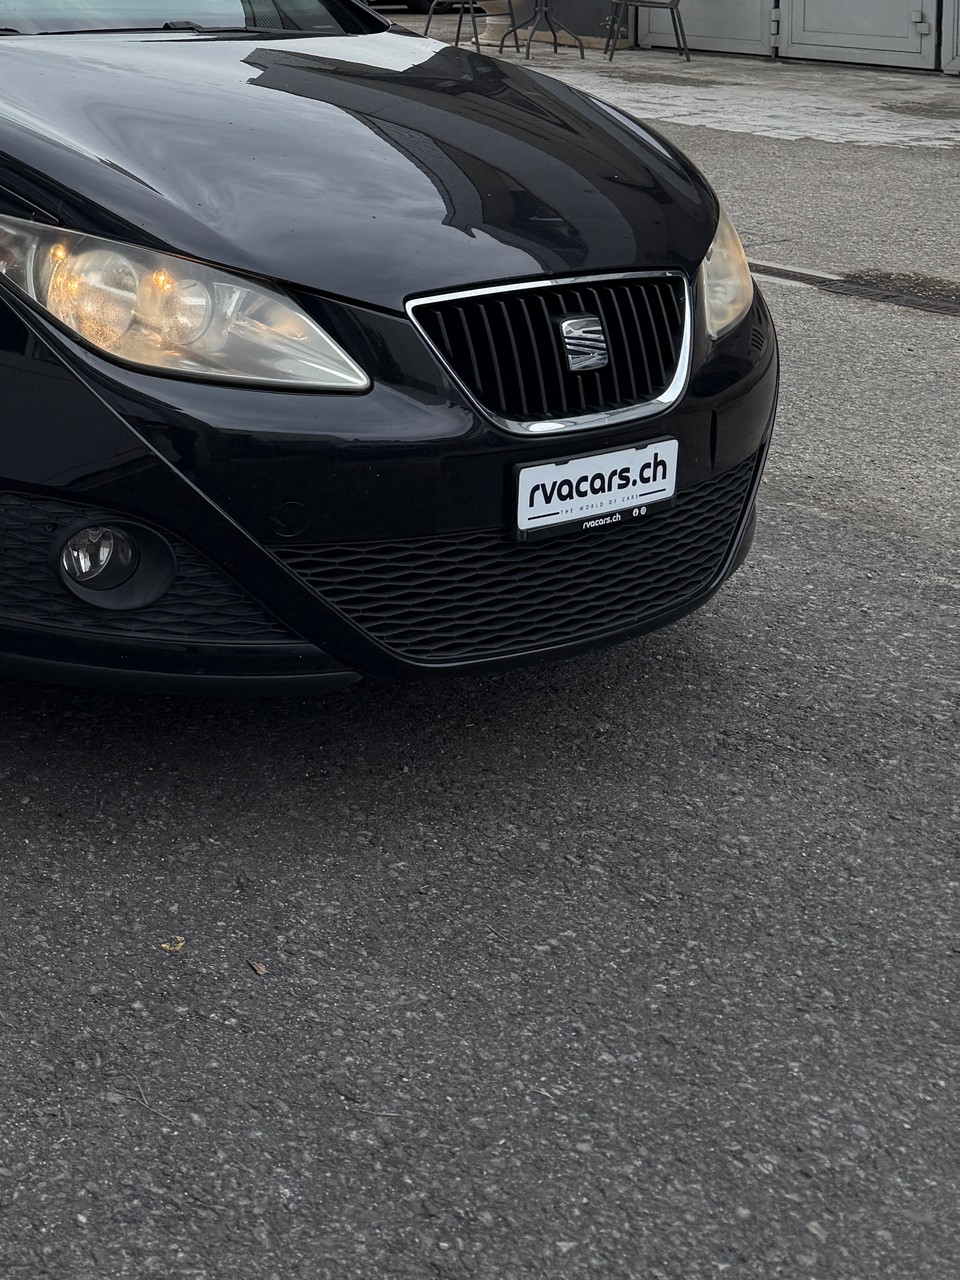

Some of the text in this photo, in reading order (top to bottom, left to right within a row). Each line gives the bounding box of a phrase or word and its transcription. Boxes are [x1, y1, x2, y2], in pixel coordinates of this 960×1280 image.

[528, 452, 668, 508] rvacars.ch
[579, 502, 604, 511] WORLD
[622, 494, 639, 502] CARS
[582, 513, 622, 529] rvacars.ch
